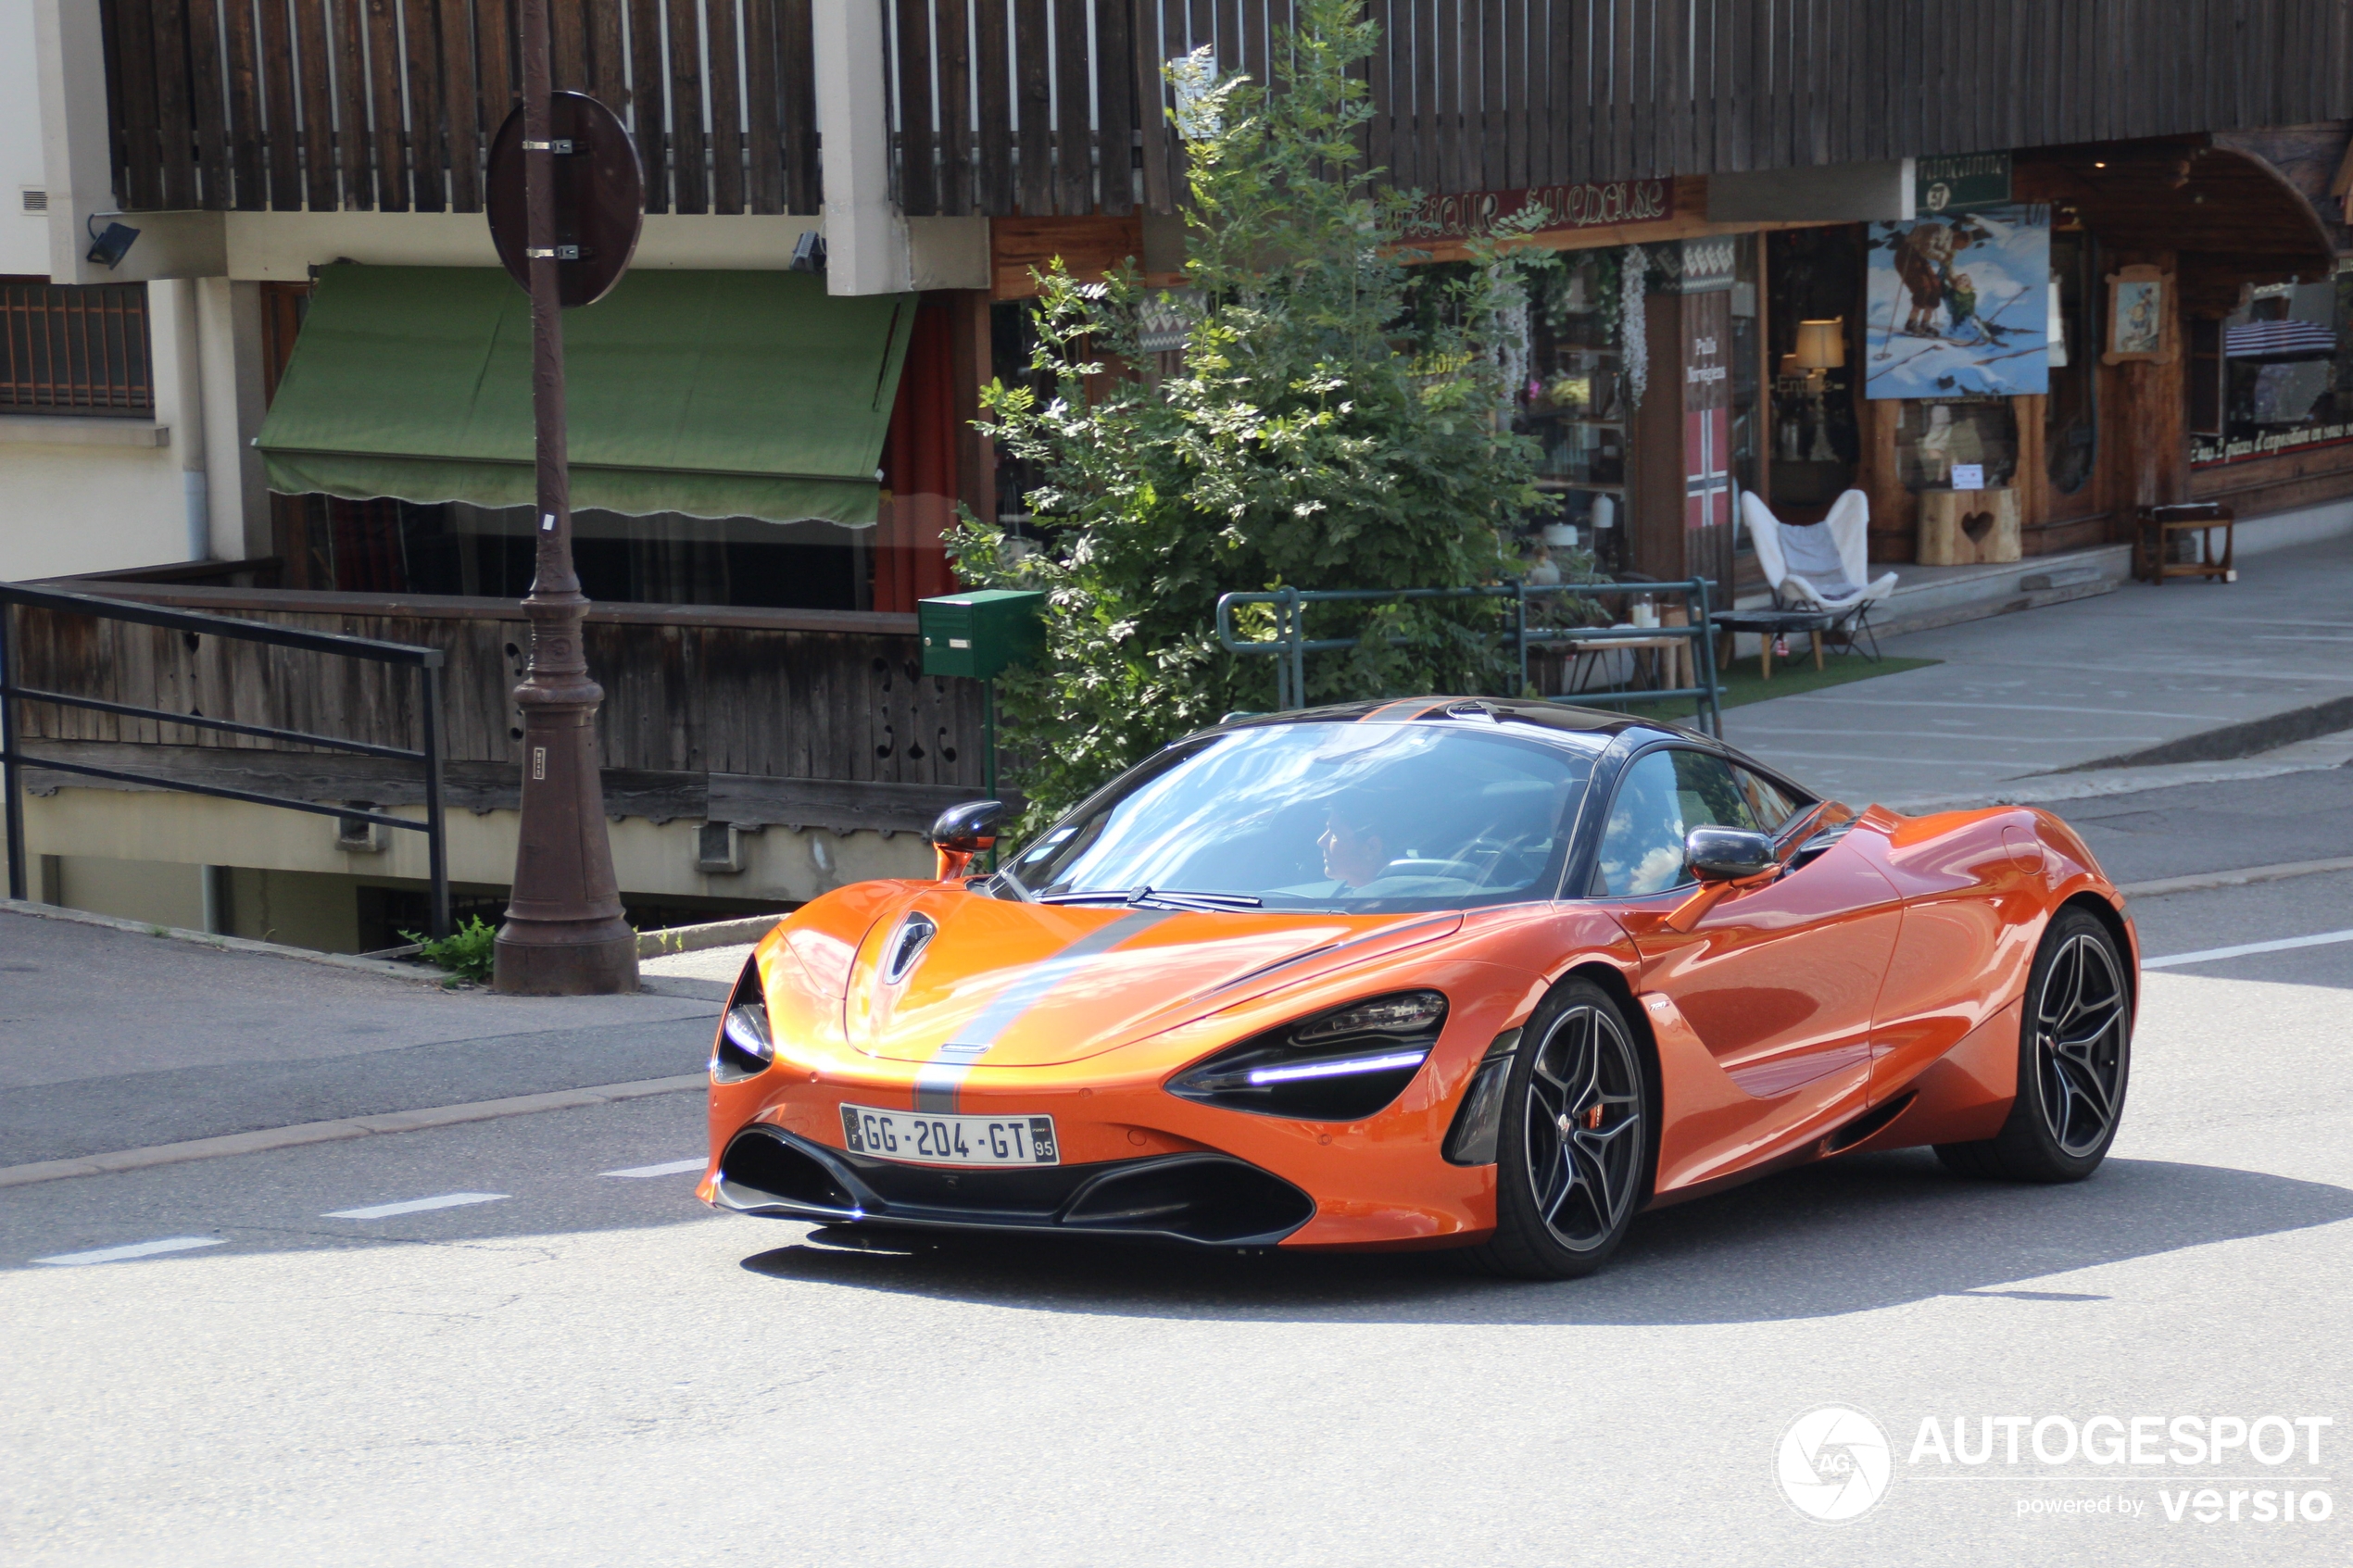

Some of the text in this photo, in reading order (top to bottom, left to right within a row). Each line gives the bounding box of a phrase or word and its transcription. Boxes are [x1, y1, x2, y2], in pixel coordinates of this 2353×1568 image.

[1695, 336, 1718, 356] Pulls
[2217, 437, 2224, 459] 2
[851, 1135, 858, 1146] F
[1034, 1141, 1053, 1156] 95
